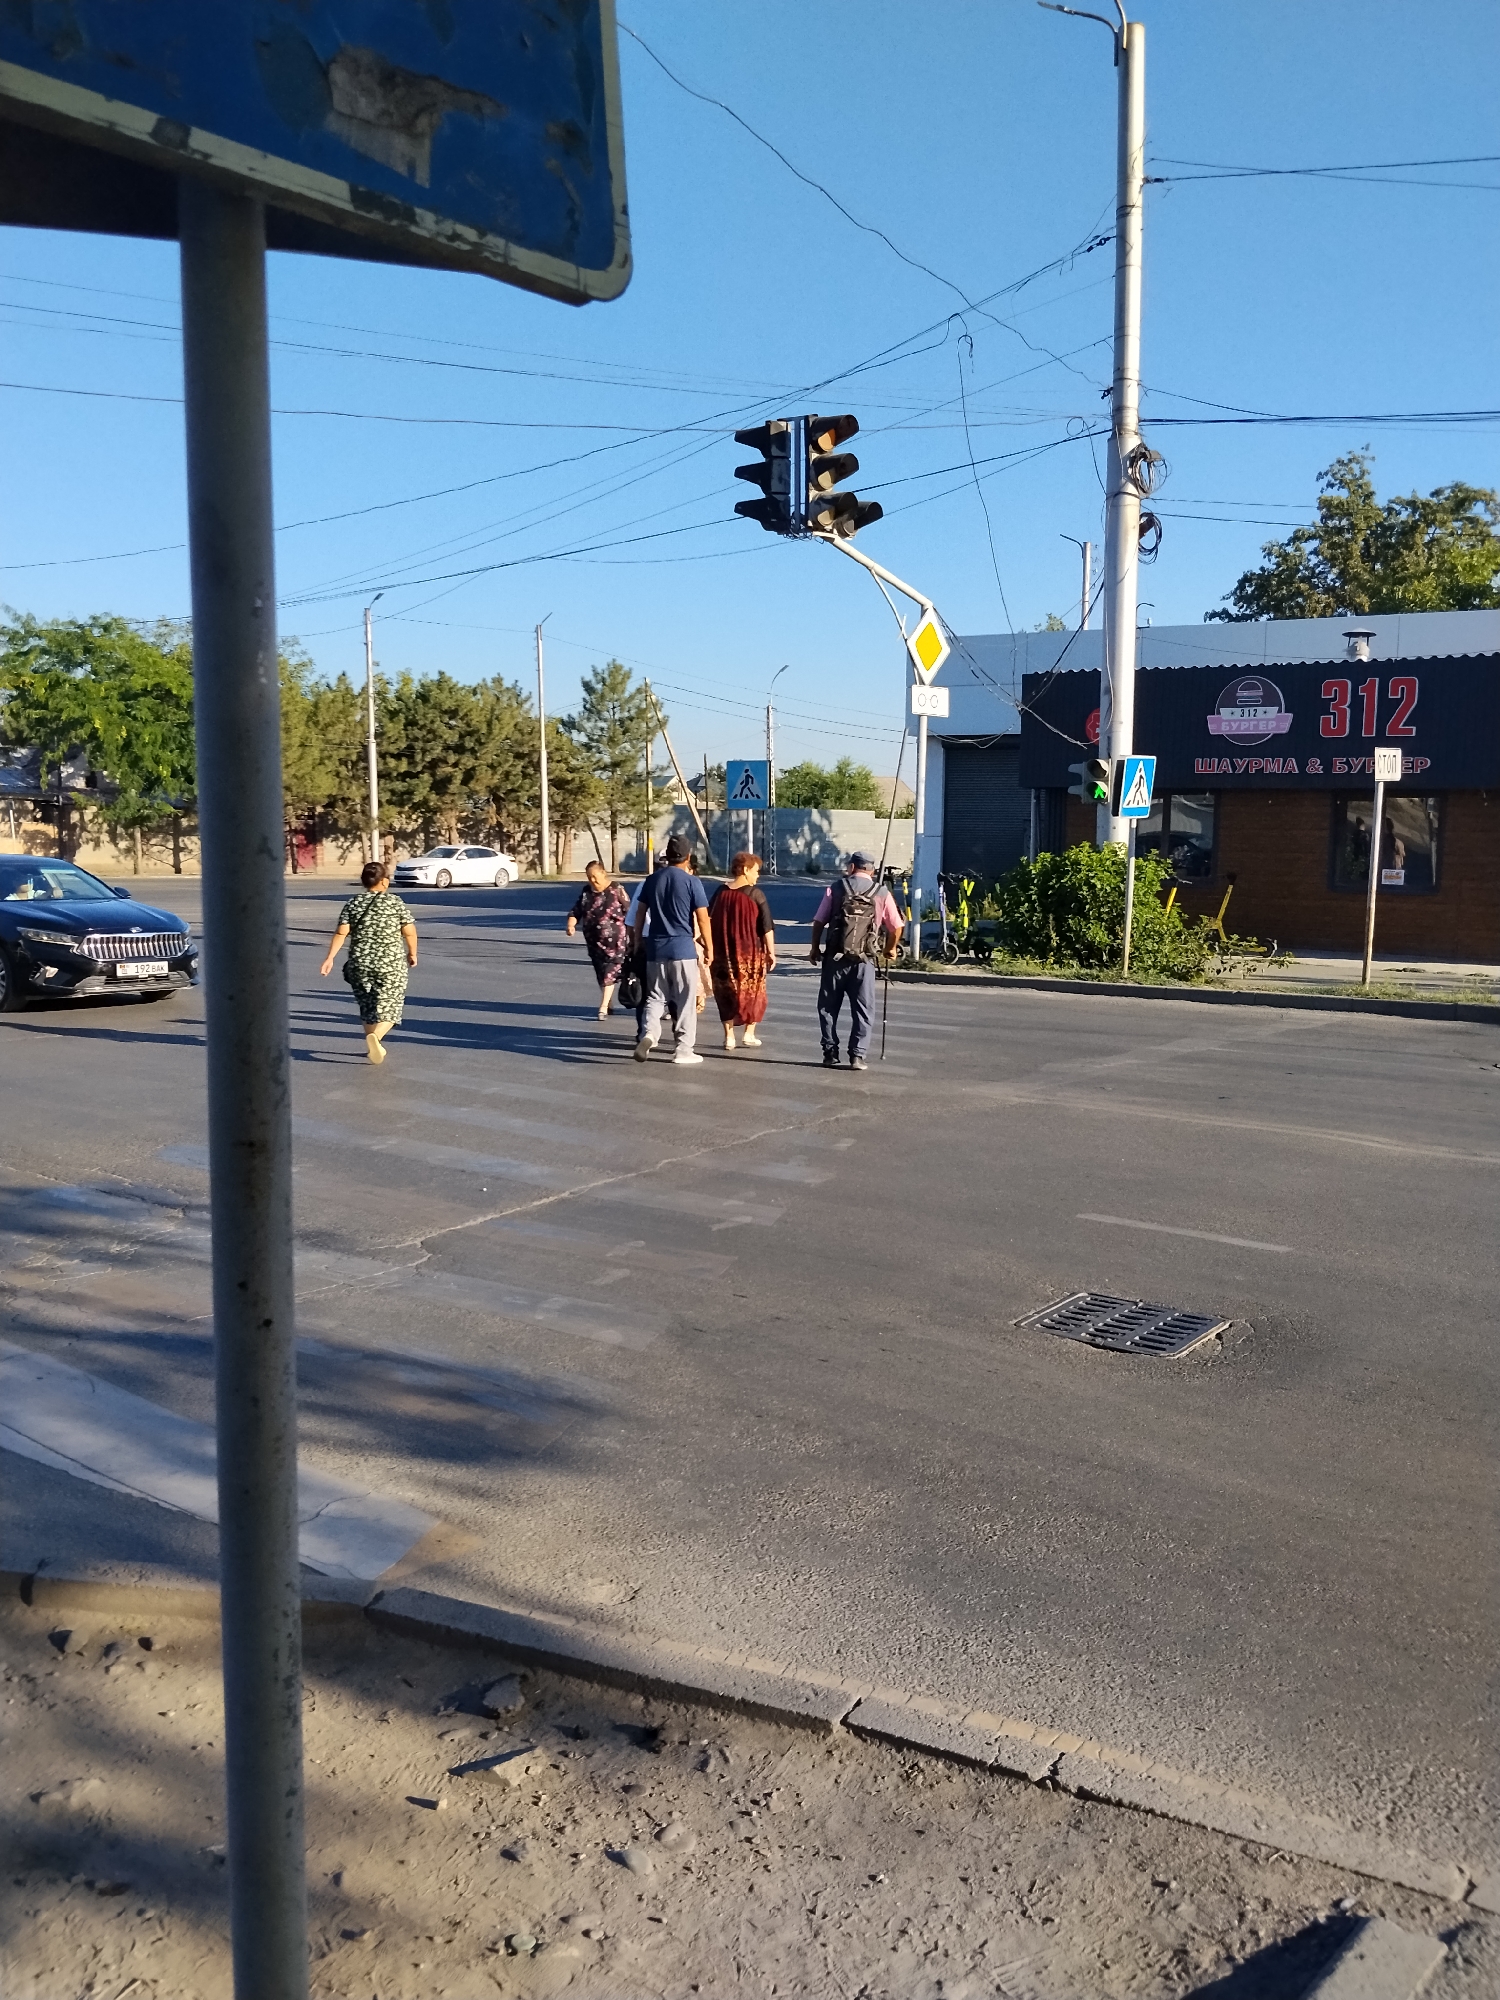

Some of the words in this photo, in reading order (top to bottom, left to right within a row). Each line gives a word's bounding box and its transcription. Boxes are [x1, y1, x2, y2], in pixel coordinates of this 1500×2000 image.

[1240, 709, 1258, 718] 312
[1320, 677, 1419, 737] 312
[1221, 721, 1277, 731] БУРГЕР
[1194, 757, 1299, 773] ШАУРМА
[1305, 757, 1324, 773] &
[1332, 757, 1431, 773] БУРЕР
[1378, 754, 1397, 774] СТОП
